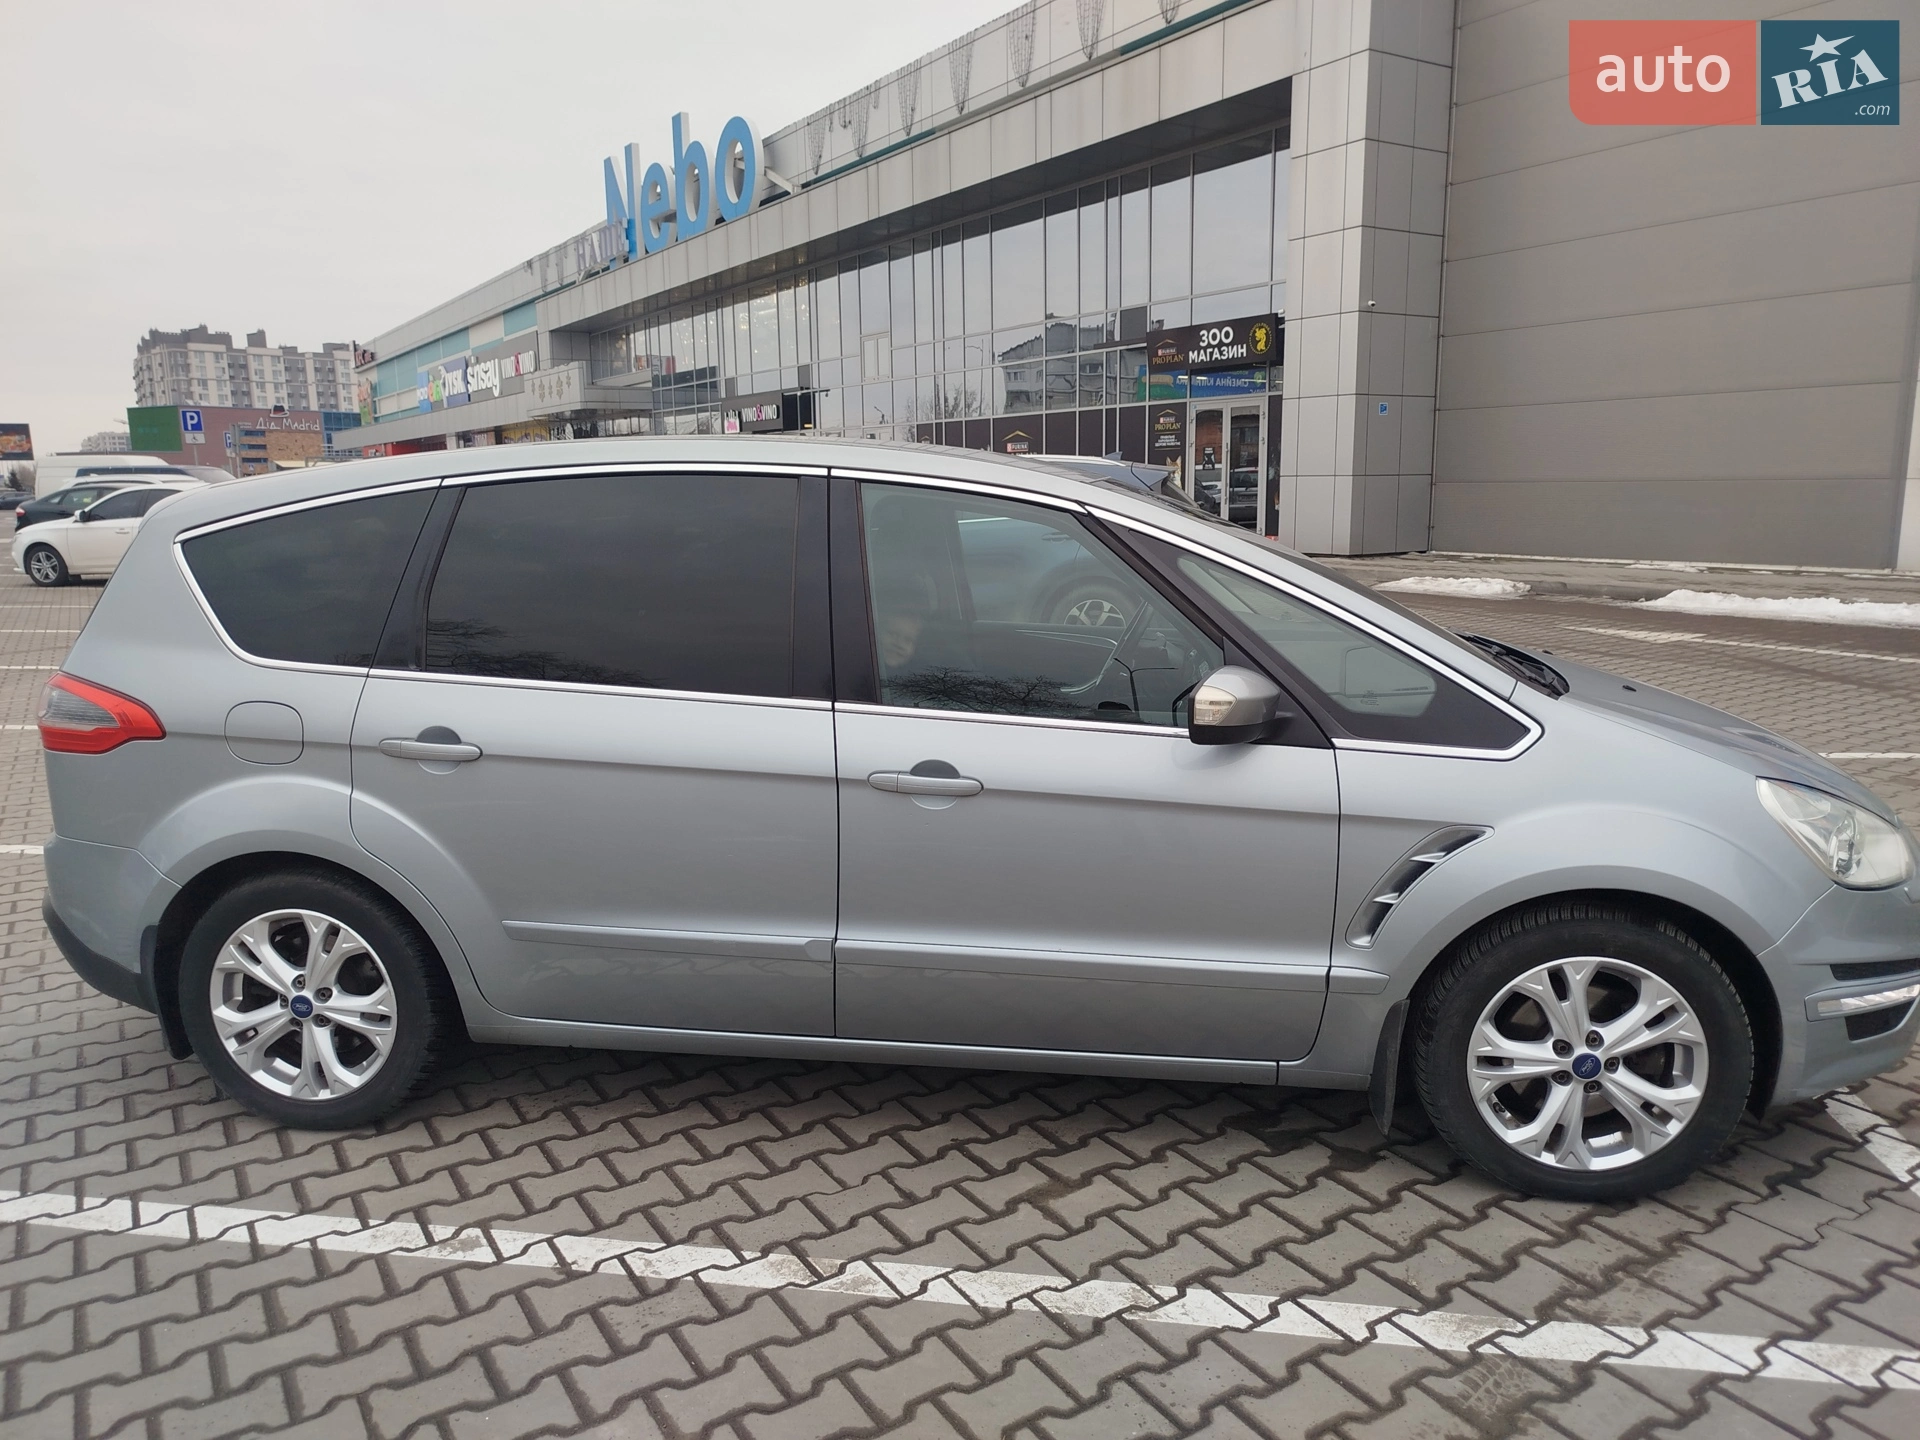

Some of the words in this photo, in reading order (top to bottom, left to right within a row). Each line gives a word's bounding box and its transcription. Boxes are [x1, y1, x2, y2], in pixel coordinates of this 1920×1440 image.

[604, 112, 762, 268] Nebo
[1199, 326, 1234, 346] ЗОО
[1189, 344, 1247, 364] МАГАЗИН
[467, 356, 500, 397] sinsay
[186, 411, 199, 431] P
[741, 404, 778, 423] VINO&VINO
[282, 418, 320, 431] Madrid
